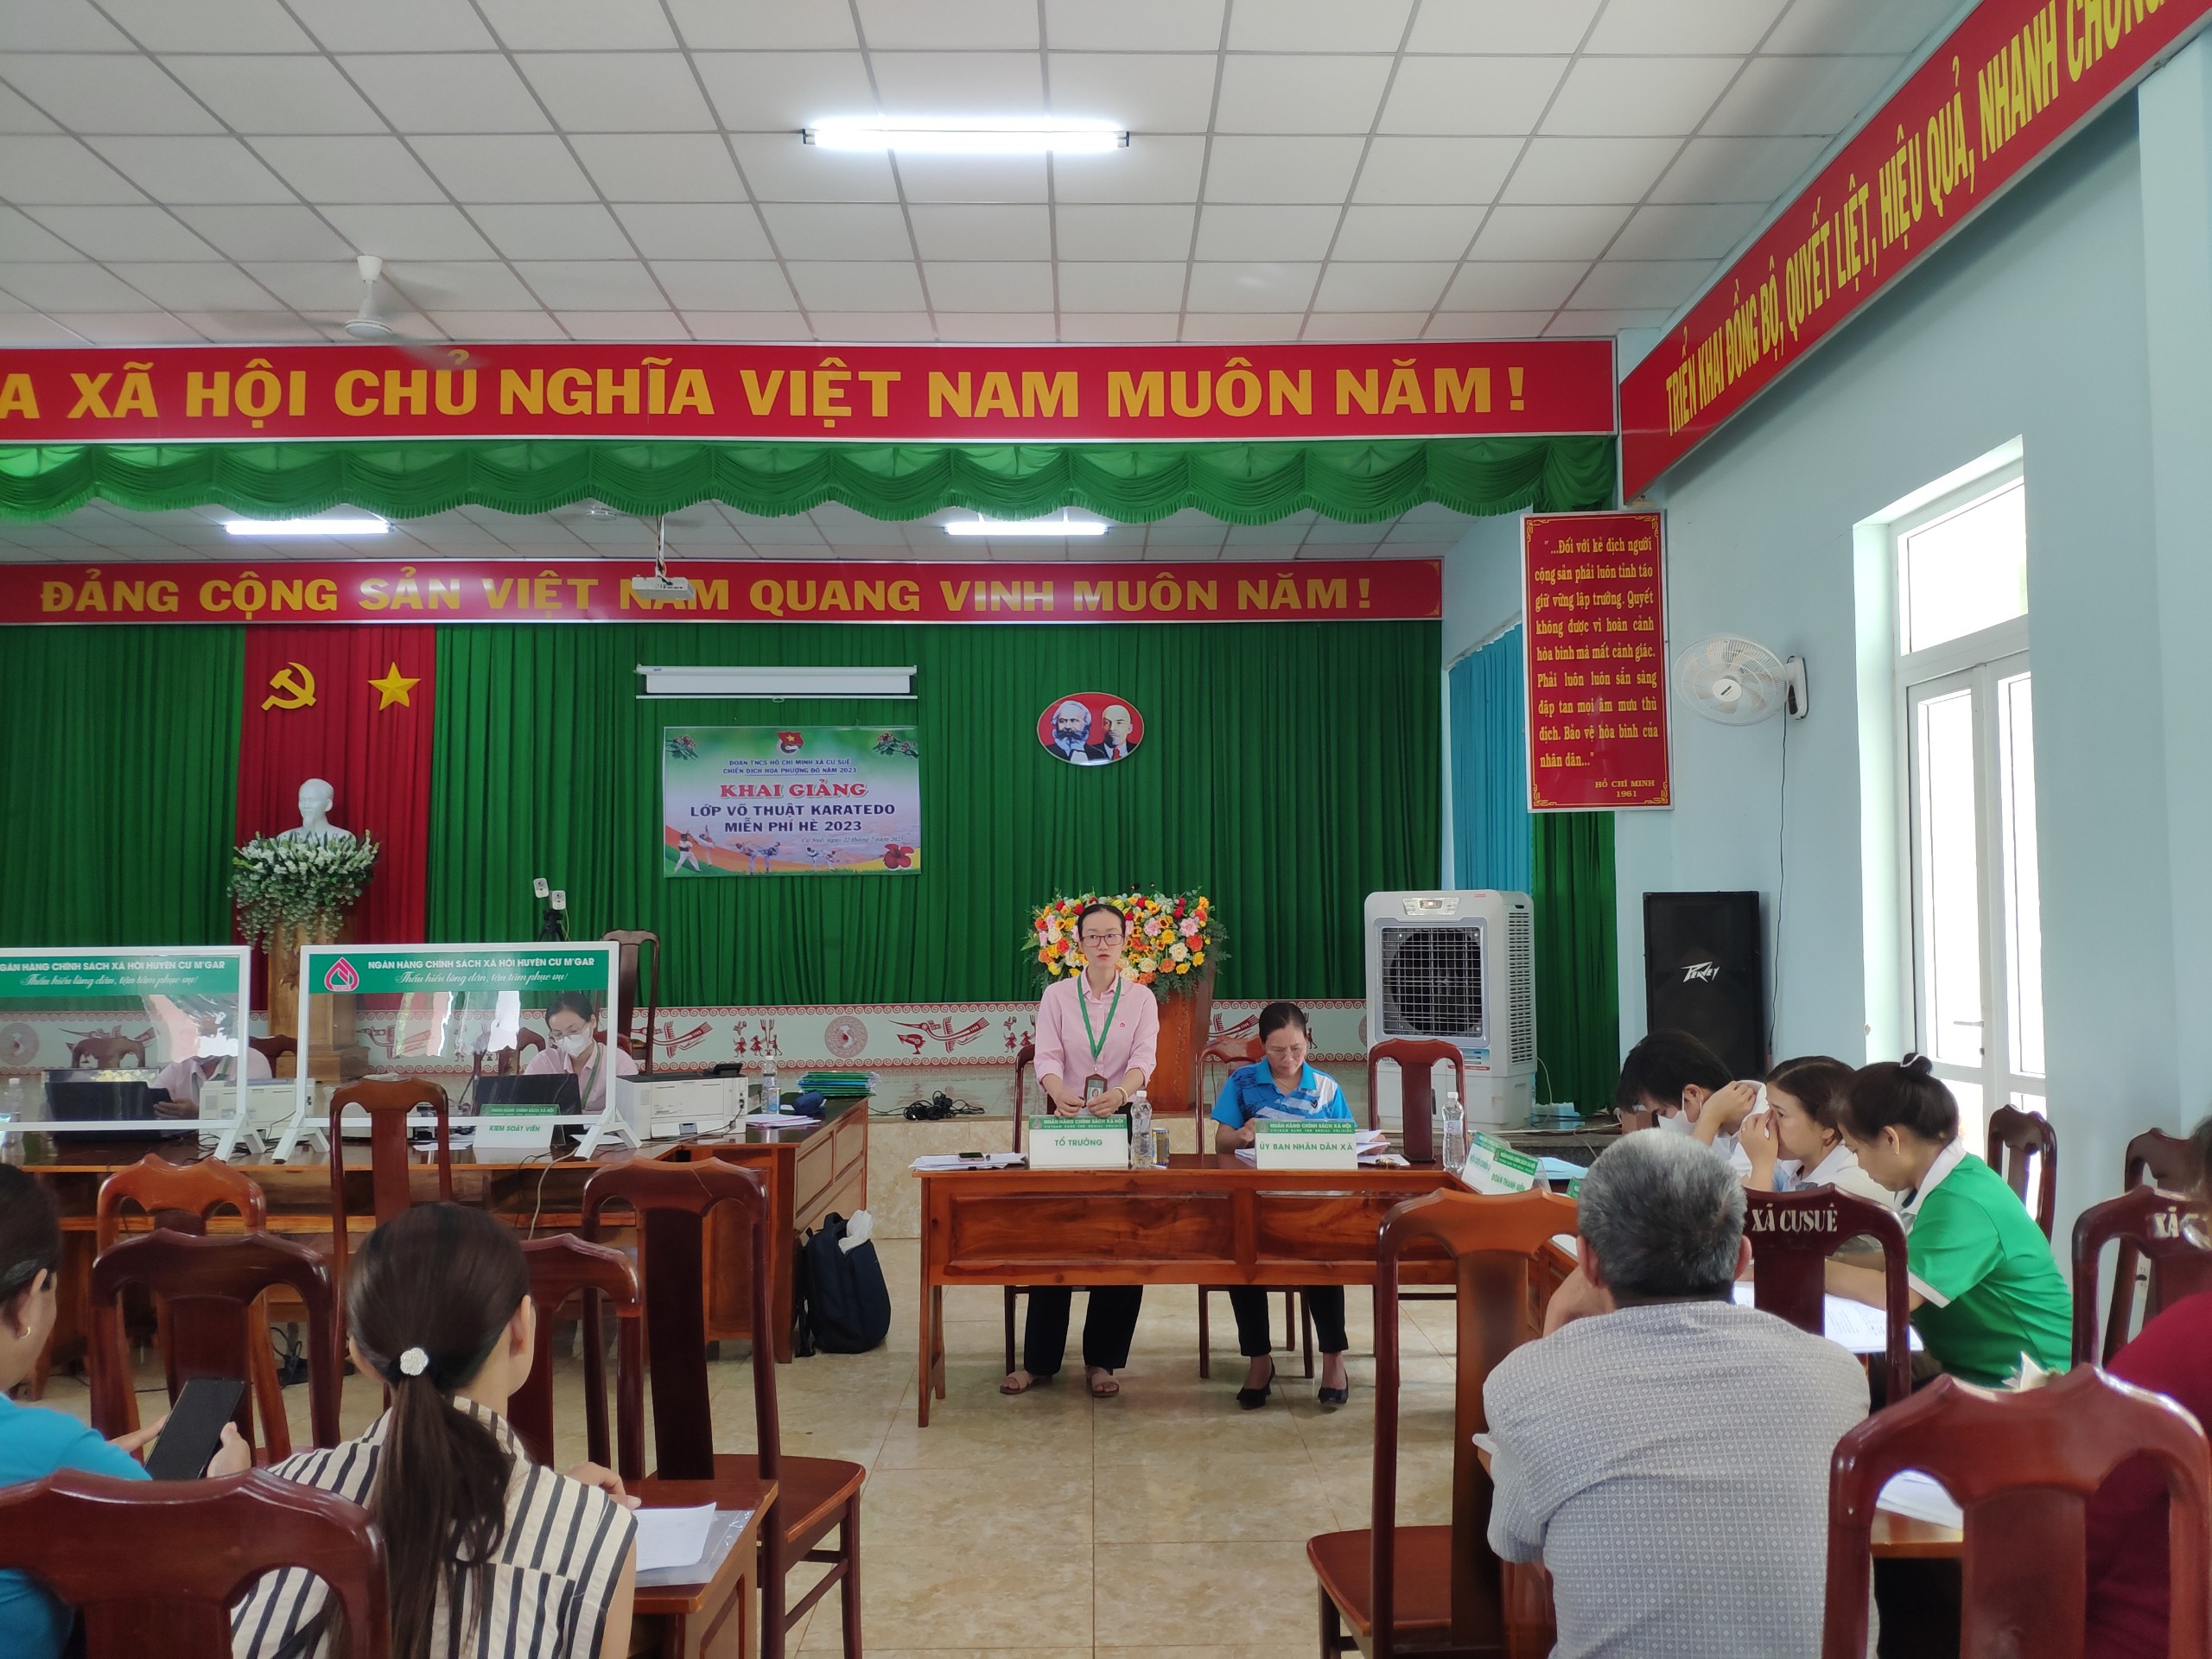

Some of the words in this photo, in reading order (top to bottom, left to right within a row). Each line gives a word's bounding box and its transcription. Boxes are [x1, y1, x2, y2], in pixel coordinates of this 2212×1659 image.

[1666, 326, 1697, 436] TRIỂN
[1698, 327, 1725, 410] KHAI
[1726, 278, 1759, 385] ĐỒNG
[1760, 251, 1783, 362] BỘ,
[1786, 196, 1831, 341] QUYẾT
[1834, 173, 1877, 291] LIỆT,
[1878, 124, 1923, 250] HIỆU
[1927, 55, 1974, 217] QUẢ,
[1978, 0, 2058, 162] NHANH
[67, 361, 158, 418] XÃ
[186, 358, 306, 429] HỘI
[334, 350, 476, 418] CHỦ
[499, 356, 715, 416] NGHĨA
[740, 357, 900, 428] VIỆT
[928, 370, 1079, 419] NAM
[1106, 357, 1314, 418] MUÔN
[1576, 538, 1590, 553] với
[1592, 537, 1603, 553] kẻ
[1606, 537, 1624, 555] địch
[1628, 537, 1652, 556] người
[1535, 567, 1555, 585] cộng
[1557, 564, 1572, 580] sản
[1575, 563, 1594, 583] phải
[1597, 564, 1616, 579] luôn
[1618, 563, 1637, 578] tỉnh
[1638, 563, 1653, 577] táo
[41, 569, 179, 611] ĐẢNG
[207, 571, 338, 620] CỘNG
[359, 567, 460, 610] SẢN
[482, 570, 599, 617] VIỆT
[748, 580, 919, 615] QUANG
[940, 580, 1053, 613] VINH
[1072, 572, 1217, 612] MUÔN
[1535, 593, 1549, 613] giữ
[1553, 593, 1573, 611] vững
[1576, 592, 1590, 610] lập
[1592, 591, 1624, 609] trường.
[1627, 587, 1653, 608] Quyết
[1536, 620, 1563, 638] không
[1568, 619, 1589, 636] được
[1592, 618, 1602, 632] vì
[1606, 617, 1628, 632] hoàn
[1633, 614, 1654, 631] cảnh
[1537, 646, 1553, 661] hòa
[1554, 645, 1574, 660] bình
[1576, 645, 1590, 659] mà
[1592, 641, 1610, 658] mất
[1612, 642, 1633, 658] cảnh
[1635, 643, 1655, 662] giác.
[1537, 671, 1557, 688] Phải
[1565, 672, 1584, 686] luôn
[1591, 671, 1611, 685] luôn
[1616, 667, 1631, 684] sẵn
[1637, 670, 1656, 688] sàng
[1538, 700, 1554, 717] đập
[1559, 700, 1573, 713] tan
[1578, 698, 1594, 715] mọi
[1599, 698, 1612, 711] âm
[1618, 698, 1637, 711] mưu
[1642, 696, 1657, 710] thù
[1539, 726, 1560, 743] địch.
[1564, 723, 1580, 741] Bảo
[1584, 725, 1595, 742] vệ
[1599, 724, 1615, 739] hòa
[1618, 723, 1638, 738] bình
[1643, 721, 1658, 737] của
[1540, 753, 1562, 767] nhân
[720, 784, 783, 798] KHAI
[789, 779, 868, 797] GIẢNG
[1595, 778, 1608, 788] HỒ
[1611, 779, 1628, 788] CHÍ
[691, 804, 721, 817] LỚP
[727, 804, 748, 817] VÕ
[754, 803, 804, 817] THUẬT
[811, 804, 895, 815] KARATEDO
[725, 817, 765, 833] MIỄN
[769, 819, 794, 832] PHÍ
[799, 819, 818, 831] HÈ
[824, 821, 862, 831] 2023
[1055, 1136, 1065, 1146] TỔ
[1068, 1137, 1103, 1146] TRƯỞNG
